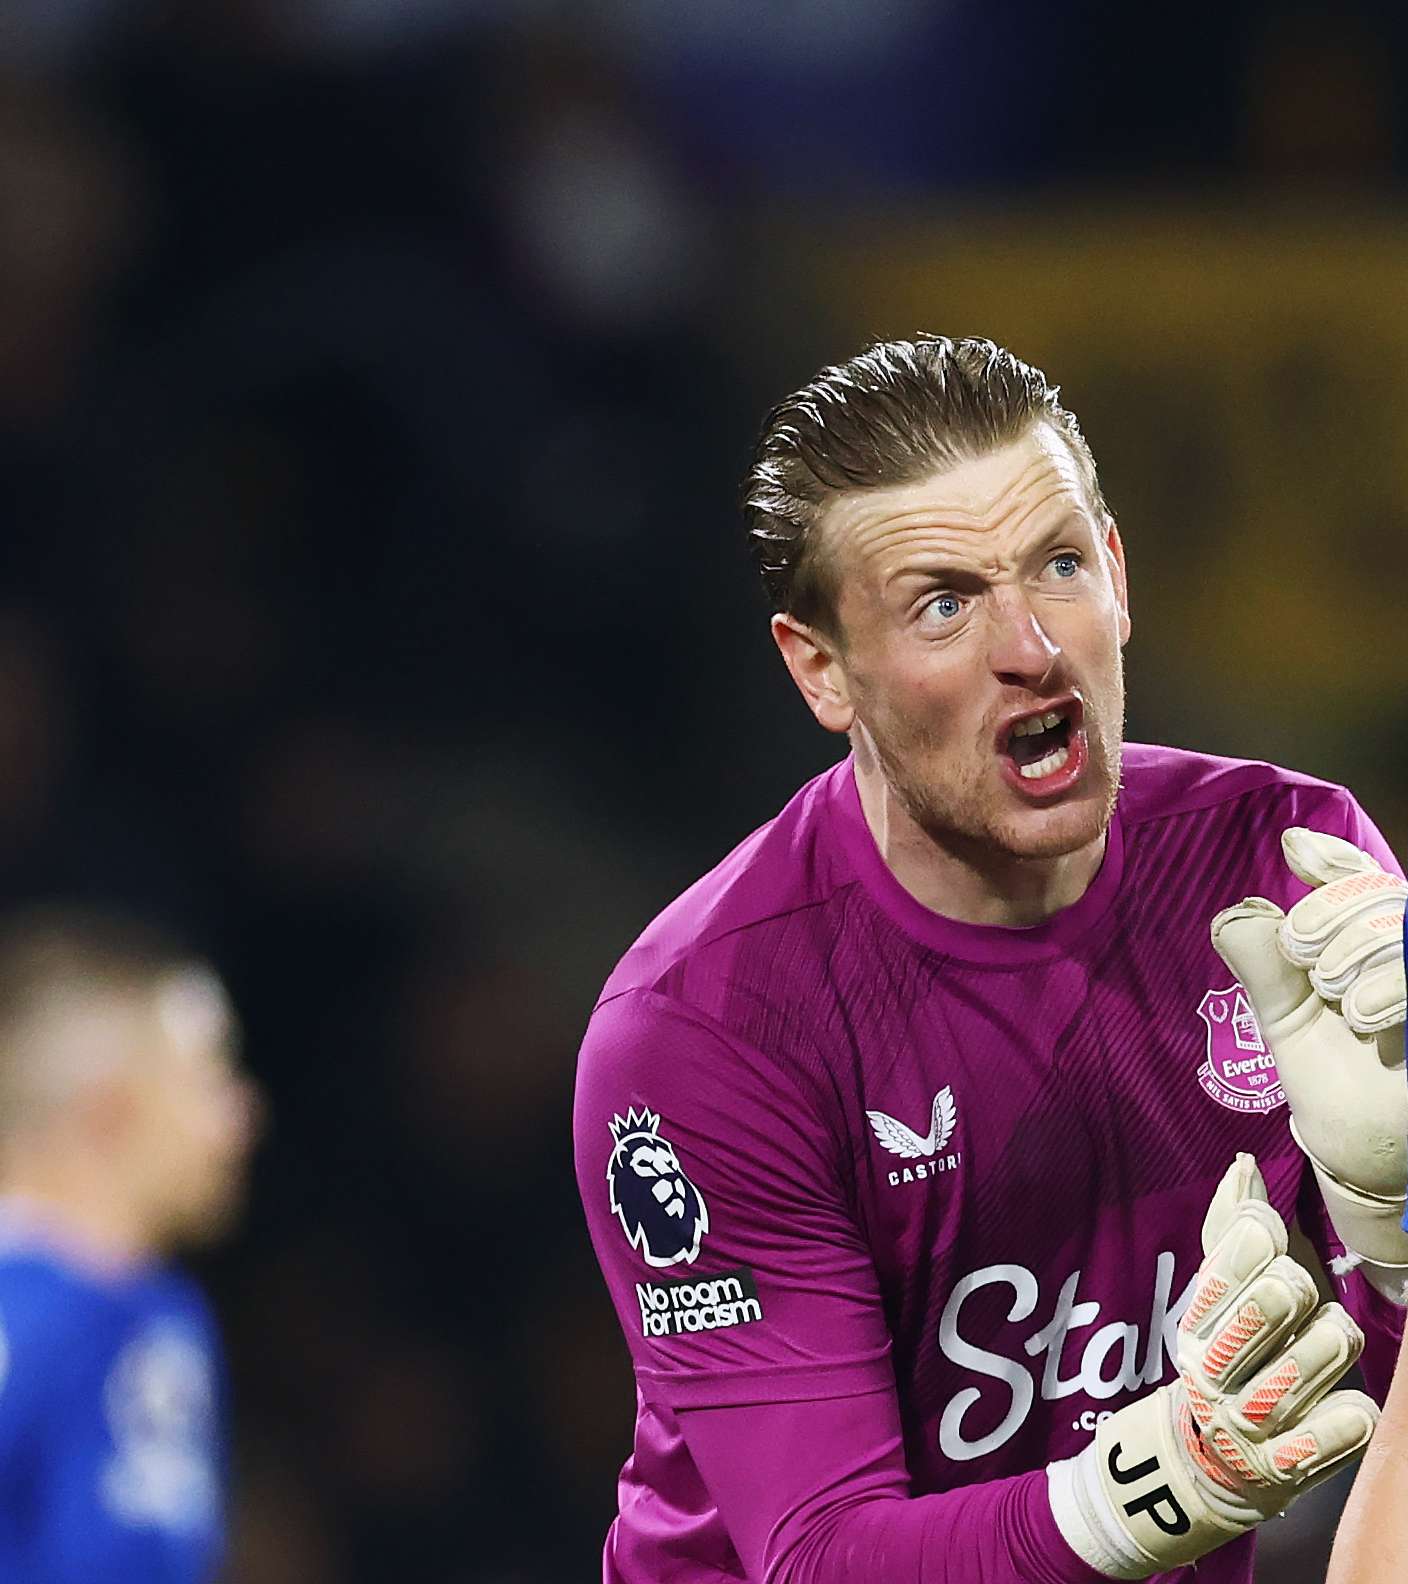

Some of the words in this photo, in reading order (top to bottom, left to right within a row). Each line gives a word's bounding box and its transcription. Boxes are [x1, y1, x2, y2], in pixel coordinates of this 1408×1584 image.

[1222, 1054, 1276, 1078] Everto
[1247, 1073, 1269, 1086] 1878
[1206, 1081, 1221, 1098] NIL
[1223, 1093, 1250, 1109] SATIS
[1253, 1094, 1276, 1109] NISI
[635, 1282, 669, 1311] No
[670, 1277, 744, 1309] room
[641, 1307, 672, 1337] for
[673, 1298, 762, 1334] racism
[939, 1251, 1199, 1461] Stak
[1107, 1441, 1192, 1538] JP
